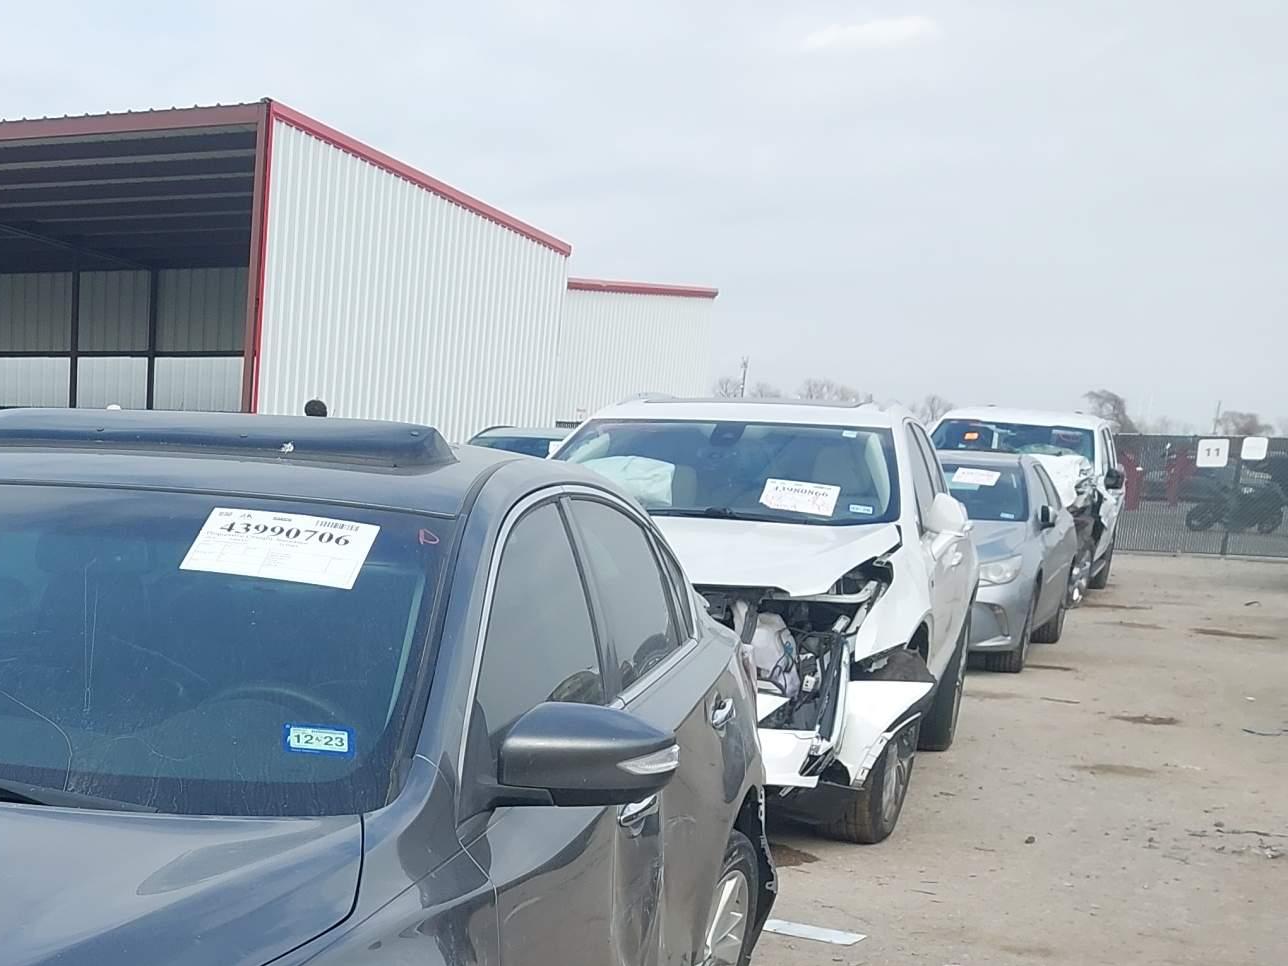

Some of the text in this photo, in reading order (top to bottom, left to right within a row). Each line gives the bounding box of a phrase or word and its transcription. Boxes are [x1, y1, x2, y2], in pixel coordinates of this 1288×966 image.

[1204, 447, 1221, 457] 11
[219, 521, 352, 547] 43990706
[294, 734, 345, 747] 12 23
